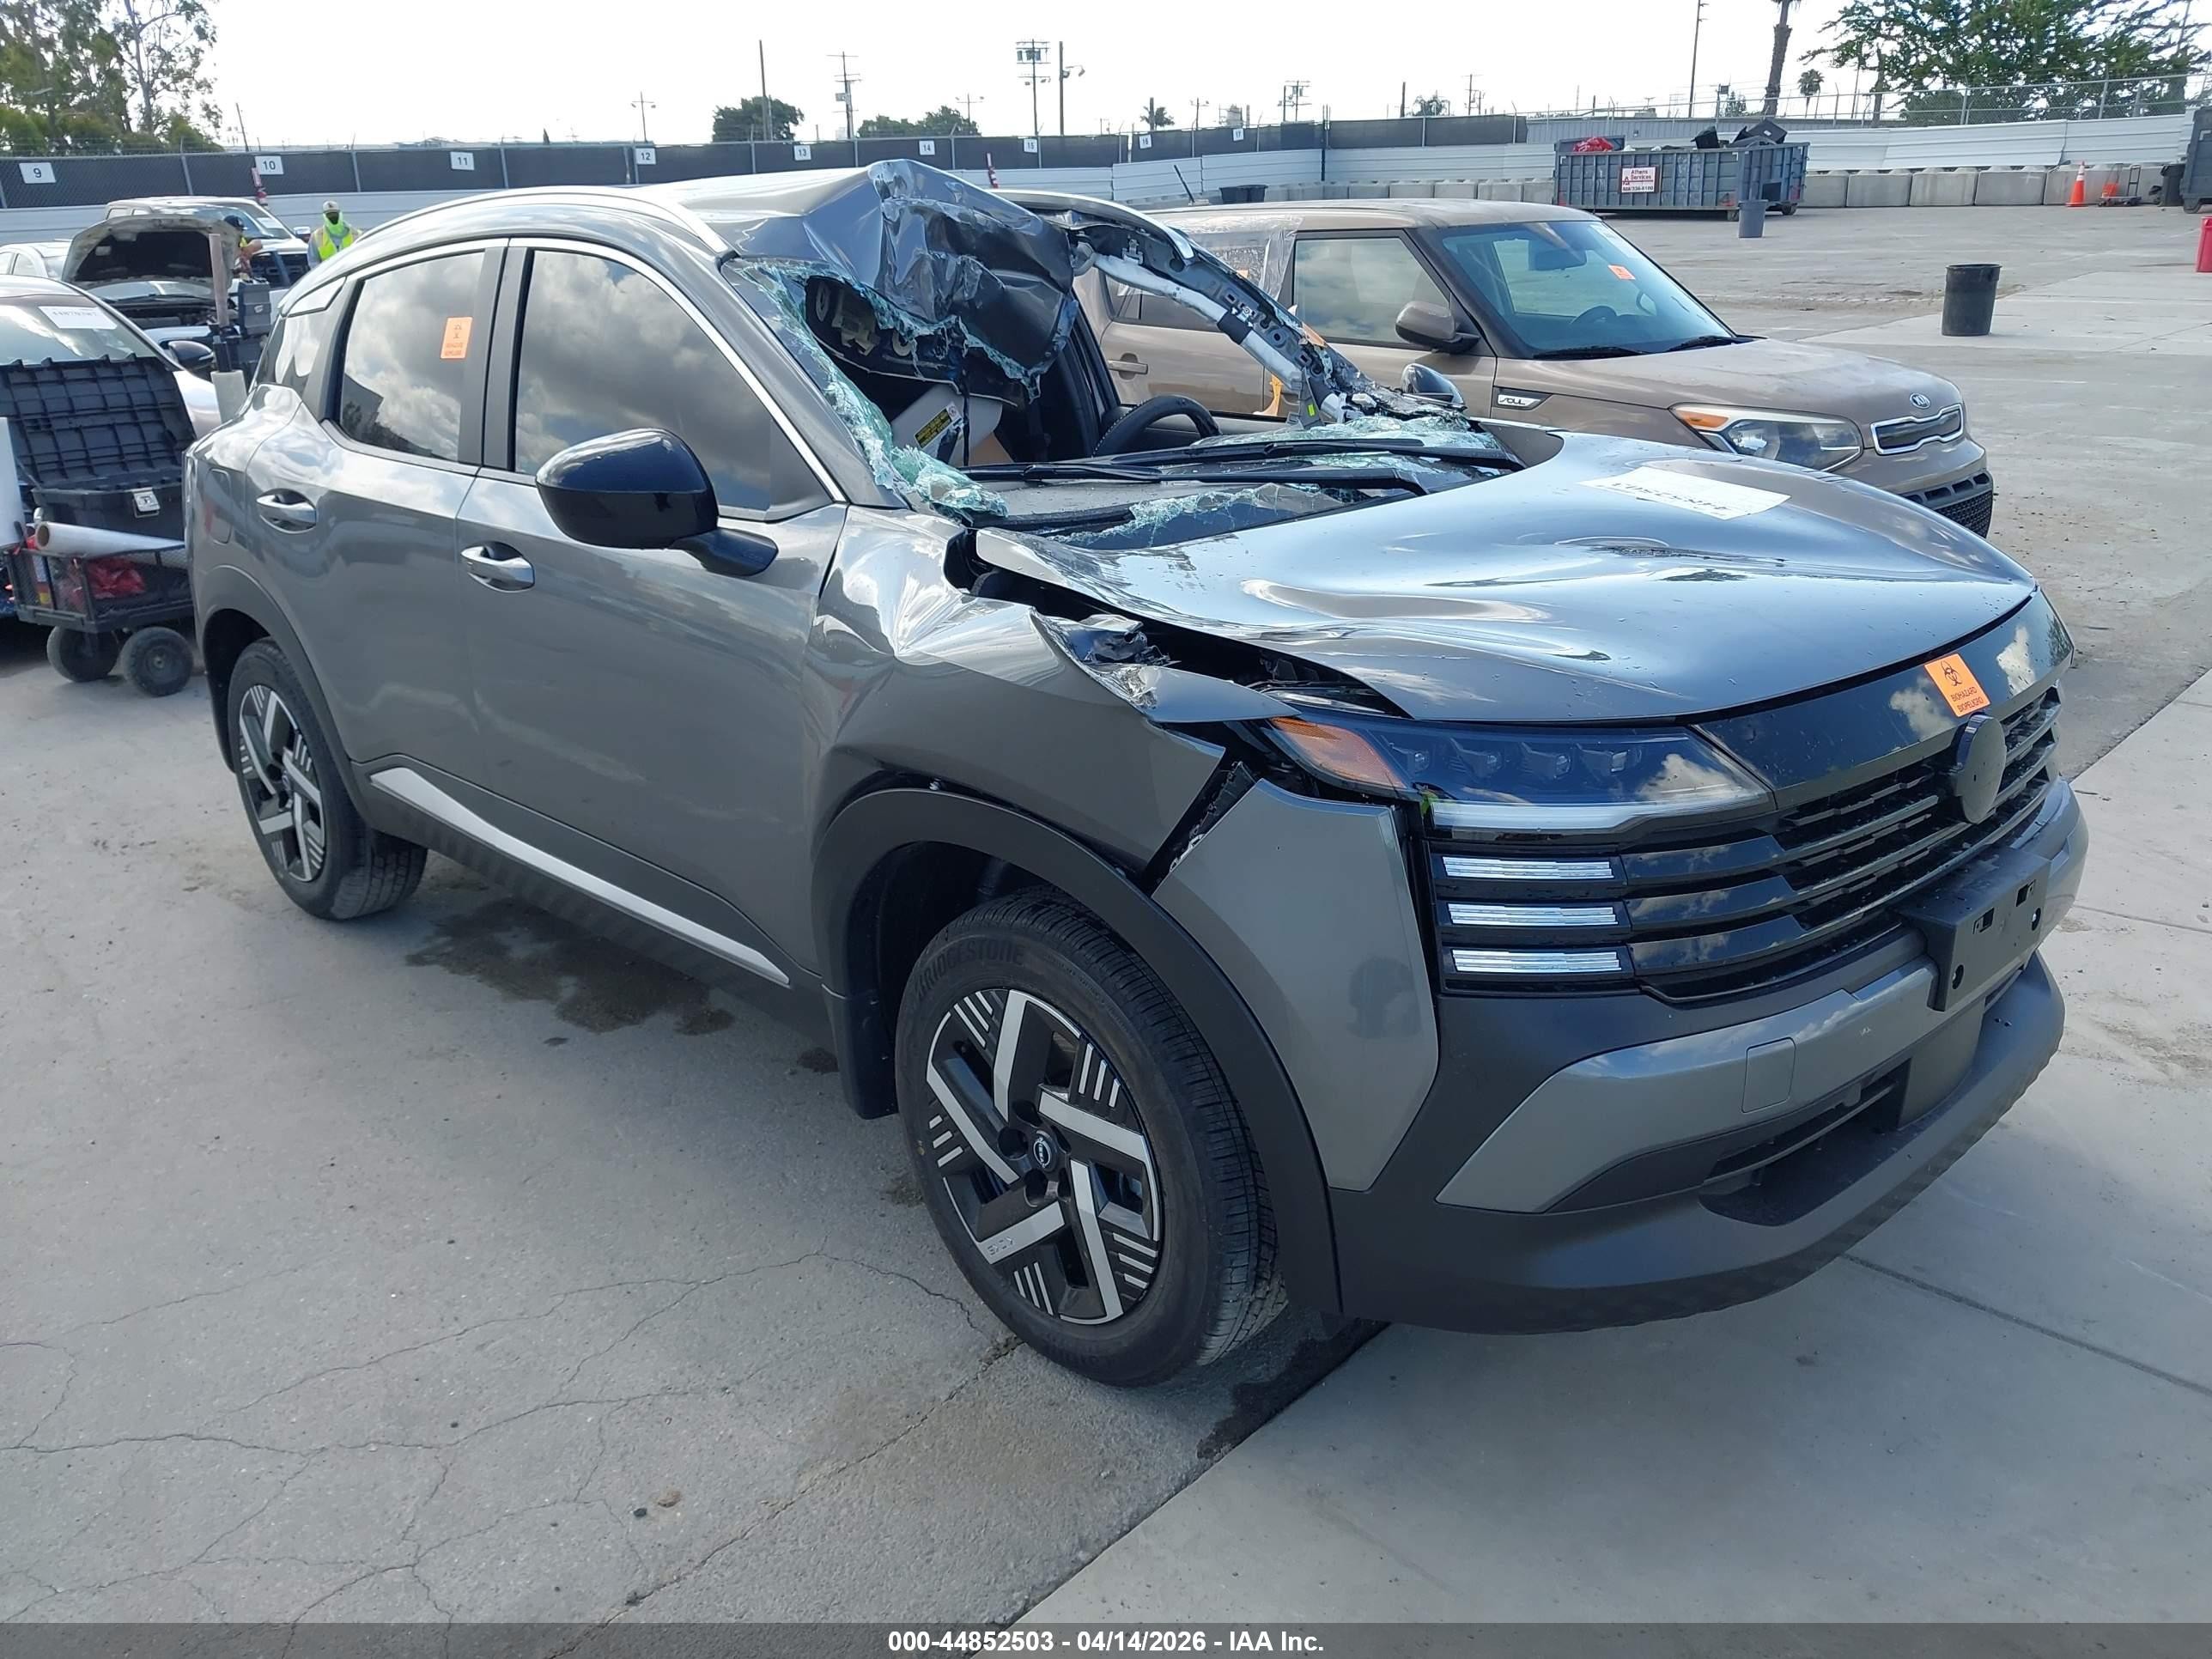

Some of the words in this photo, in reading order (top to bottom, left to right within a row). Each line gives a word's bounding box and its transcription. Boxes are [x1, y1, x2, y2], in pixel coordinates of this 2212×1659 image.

[1027, 142, 1034, 150] 15
[641, 152, 651, 161] 12
[798, 149, 806, 157] 13
[262, 160, 276, 171] 10
[457, 156, 469, 166] 11
[33, 167, 42, 179] 9
[1950, 686, 1978, 702] BIOHAZARD
[1957, 696, 1984, 713] BIOPELIGRO
